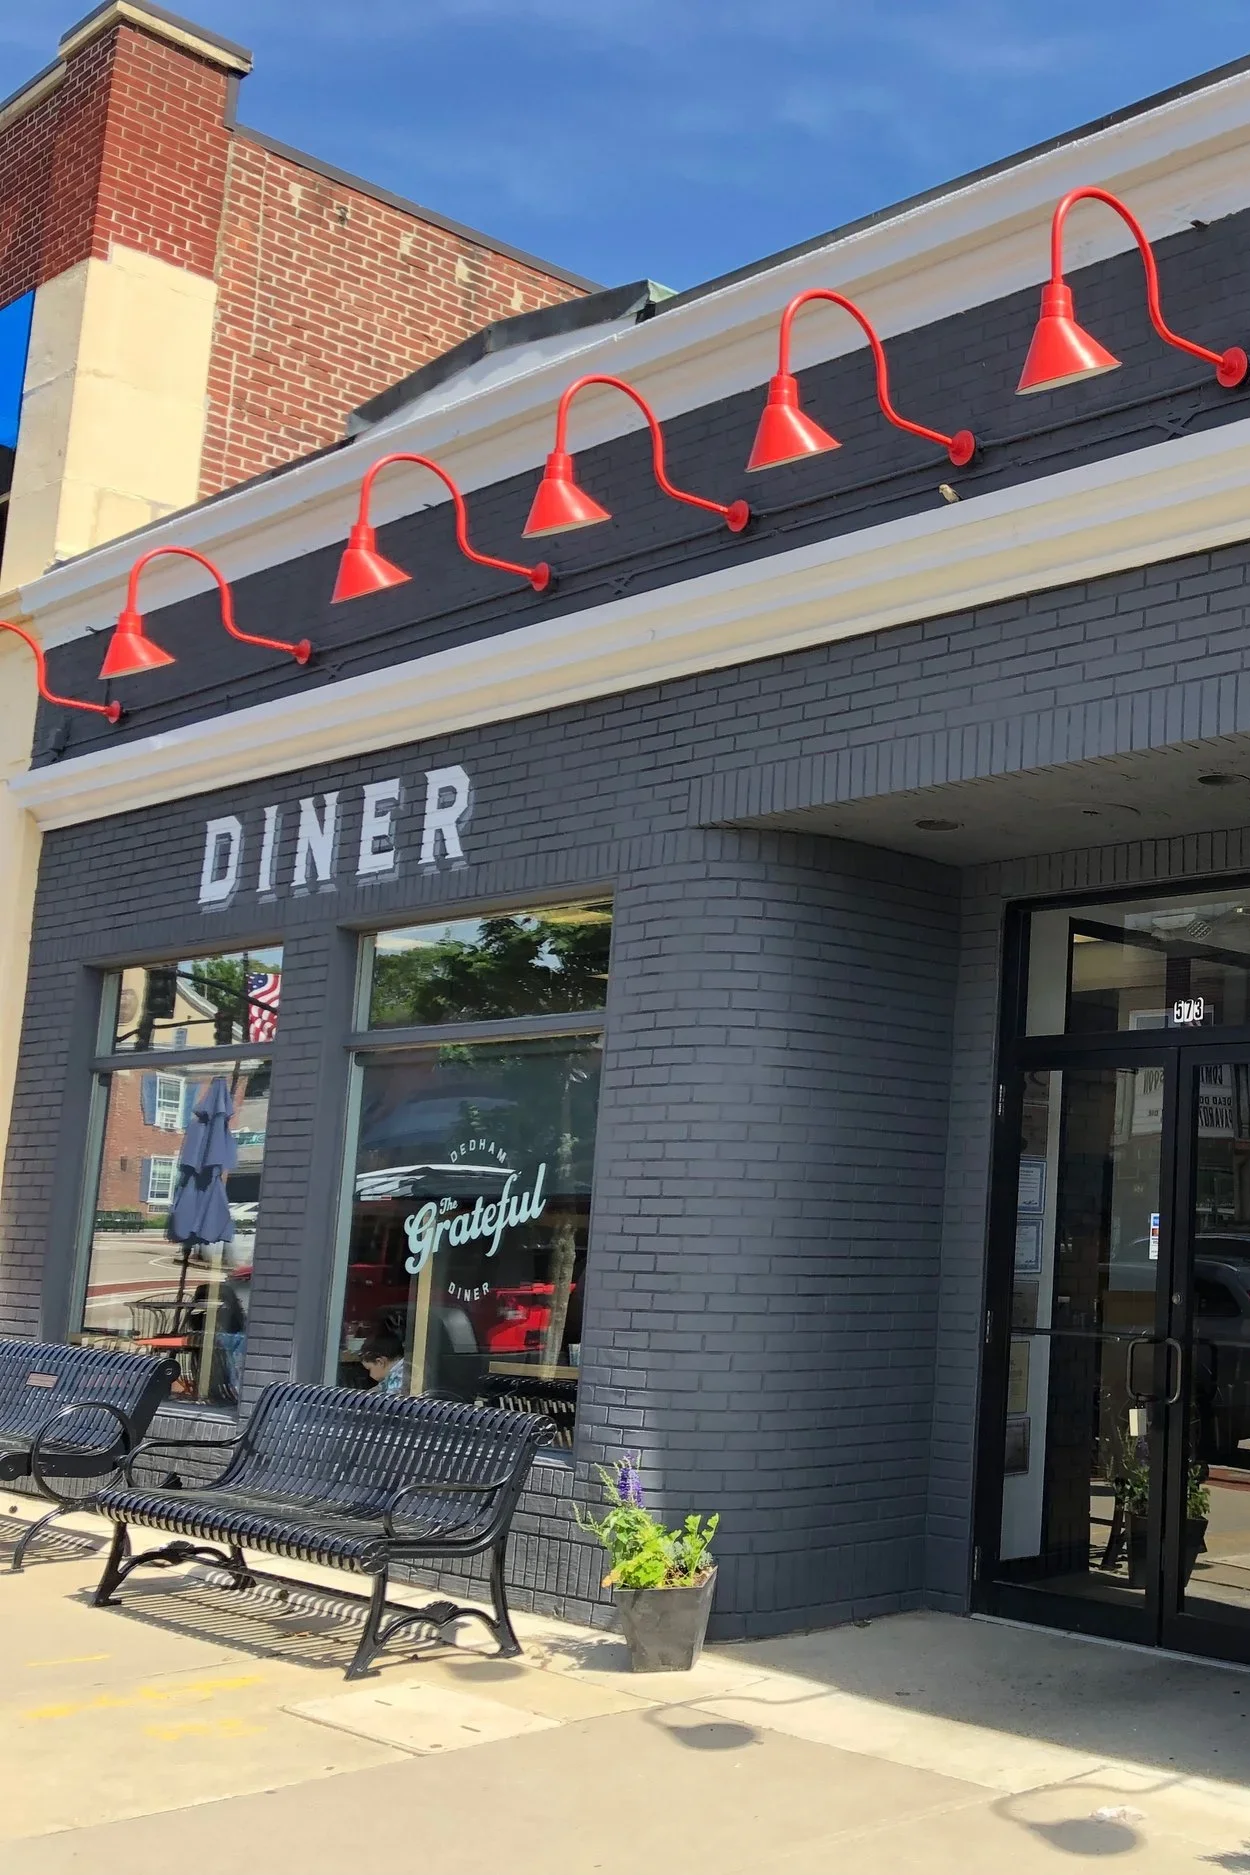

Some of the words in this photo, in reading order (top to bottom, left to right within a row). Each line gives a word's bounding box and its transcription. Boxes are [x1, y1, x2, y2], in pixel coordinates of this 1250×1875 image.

[198, 764, 472, 906] DINER
[1174, 998, 1203, 1021] 573
[450, 1138, 507, 1163] DEDHAM
[439, 1196, 459, 1215] The
[404, 1162, 547, 1275] Grateful
[448, 1281, 490, 1302] DINER
